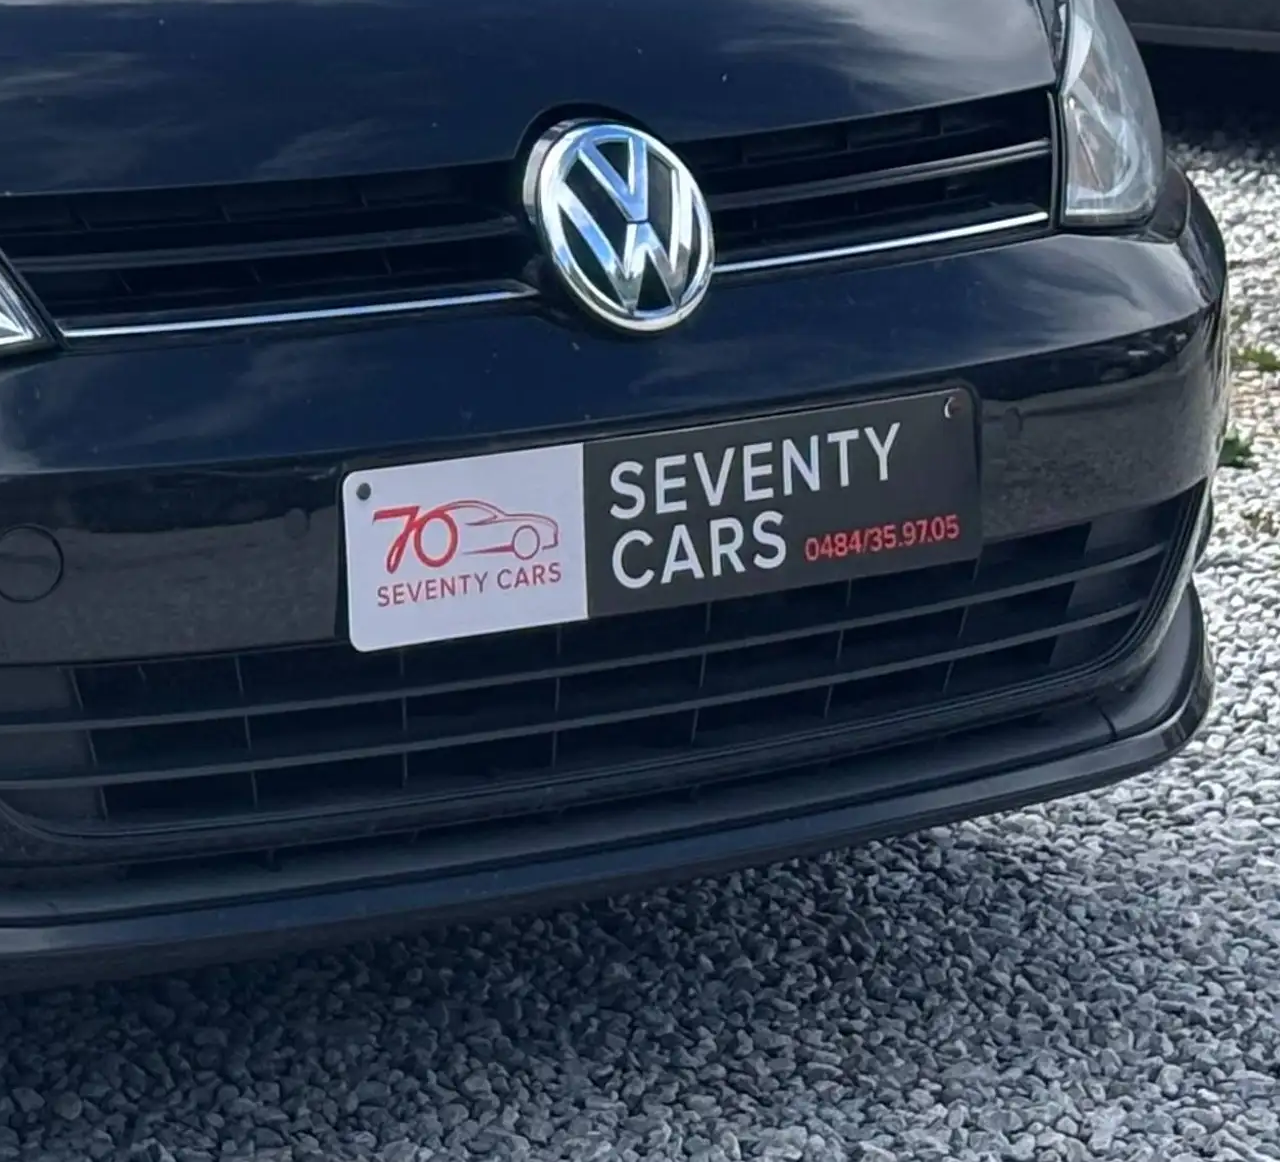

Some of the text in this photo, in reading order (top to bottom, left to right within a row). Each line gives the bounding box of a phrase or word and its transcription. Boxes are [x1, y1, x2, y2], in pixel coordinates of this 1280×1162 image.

[550, 131, 700, 321] VW
[610, 422, 901, 519] SEVENTY
[372, 505, 458, 574] 70
[612, 510, 786, 588] CARS
[805, 514, 960, 561] 0484/35.97.05
[377, 562, 562, 607] SEVENTY CARS
